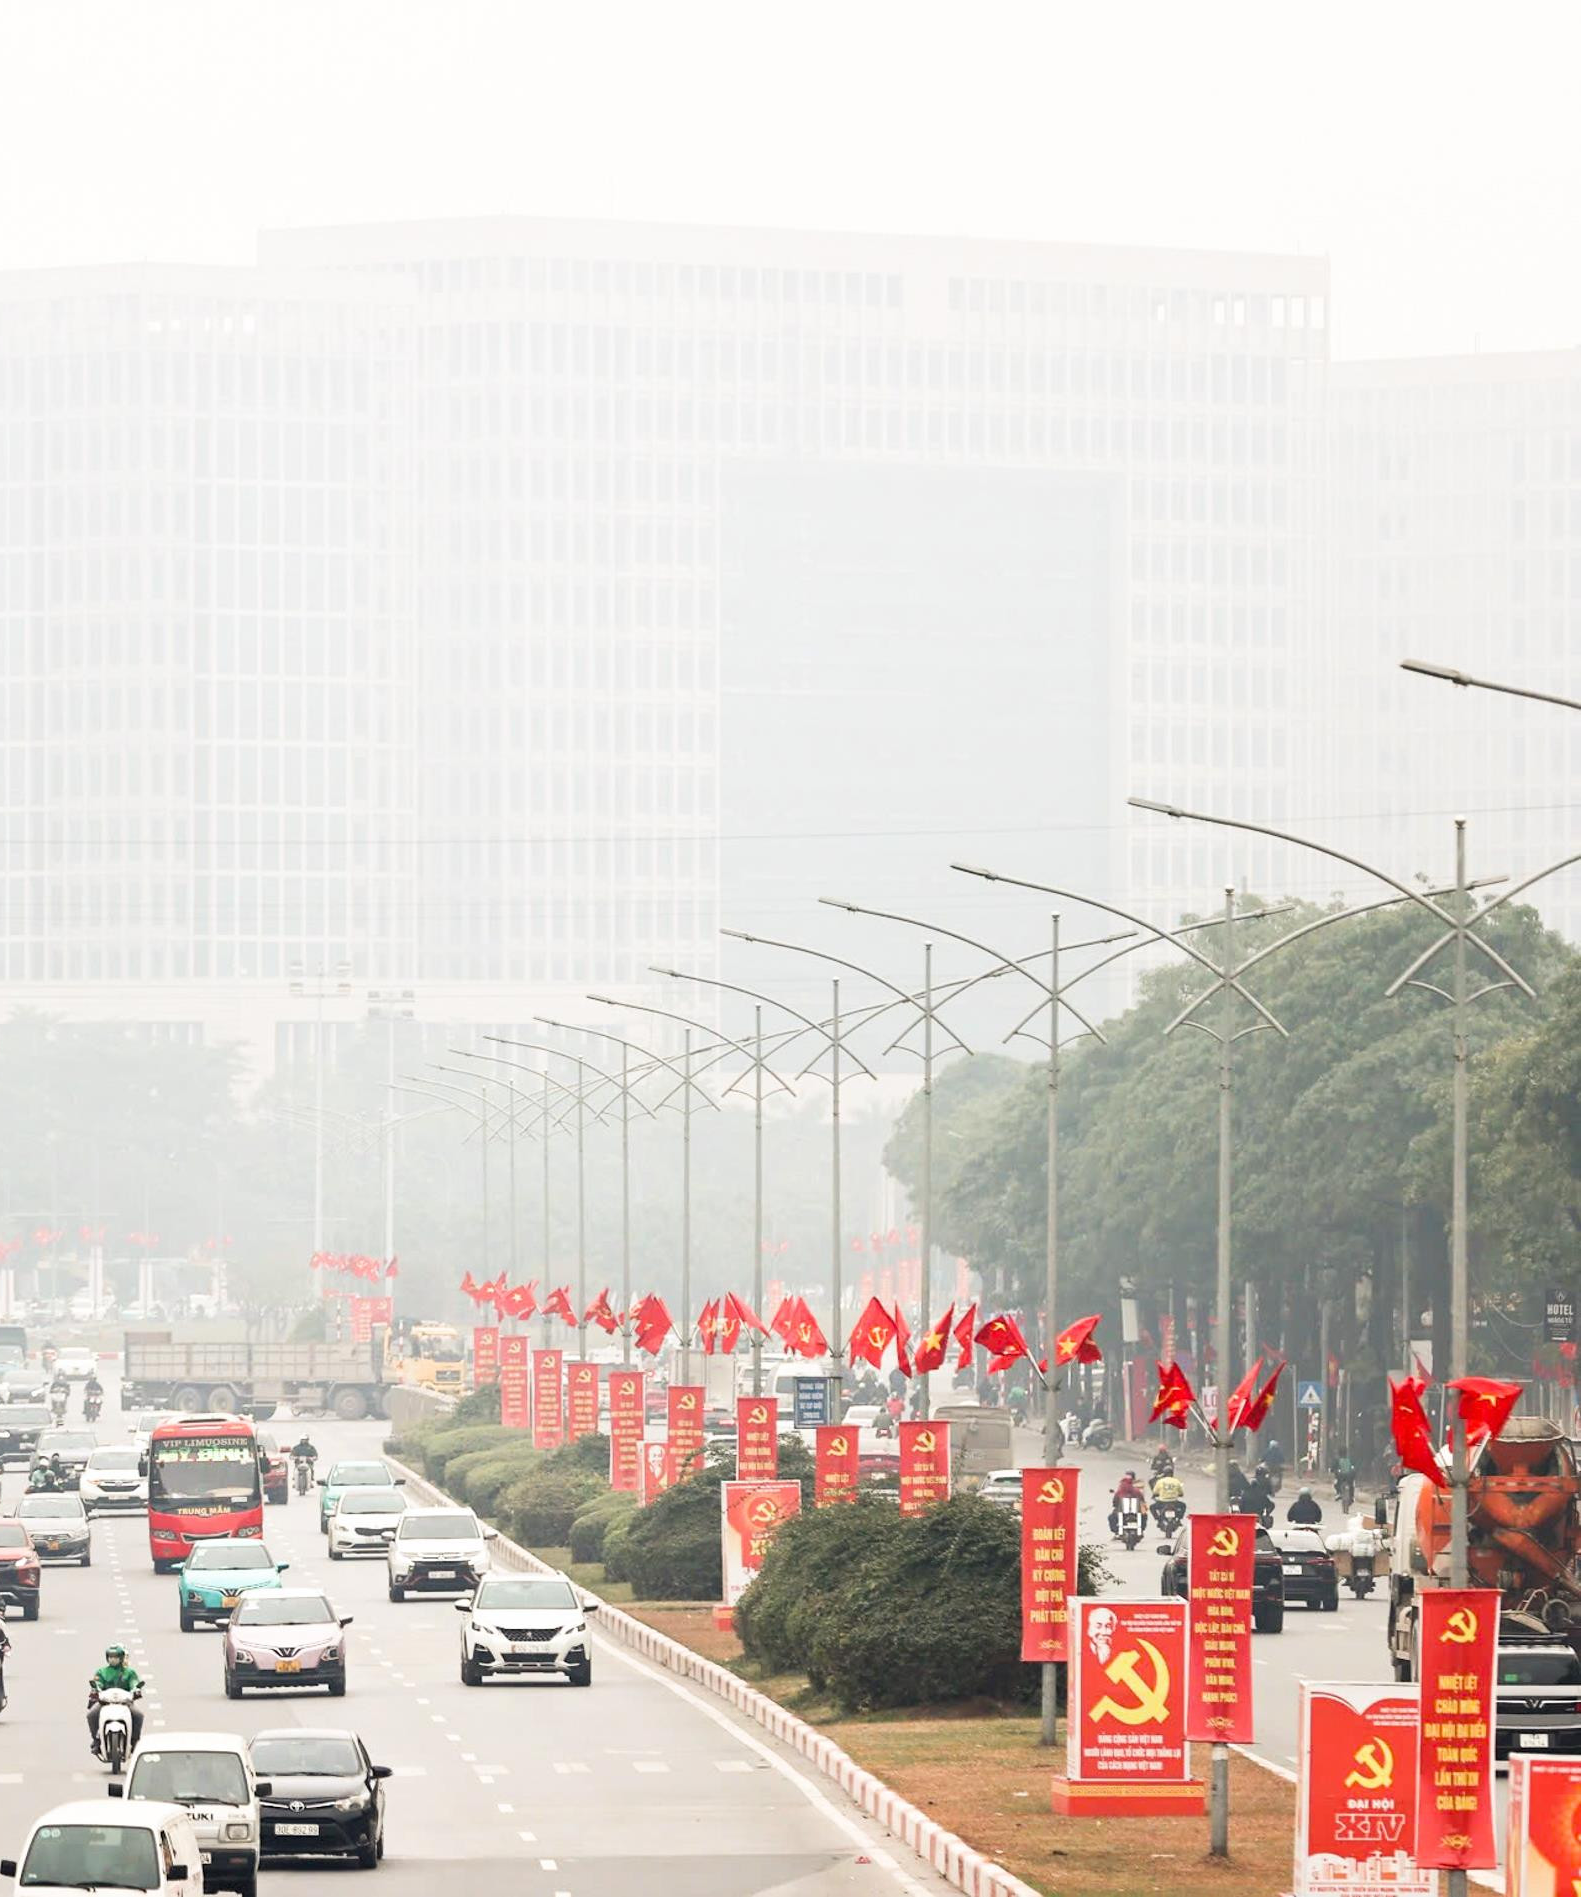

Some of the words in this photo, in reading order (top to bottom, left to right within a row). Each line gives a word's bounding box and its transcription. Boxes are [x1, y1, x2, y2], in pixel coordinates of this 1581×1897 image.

[1547, 1304, 1573, 1315] HOTEL
[1347, 1799, 1369, 1811] ĐẠI
[1372, 1798, 1395, 1811] HỘI
[1335, 1813, 1406, 1841] XIV
